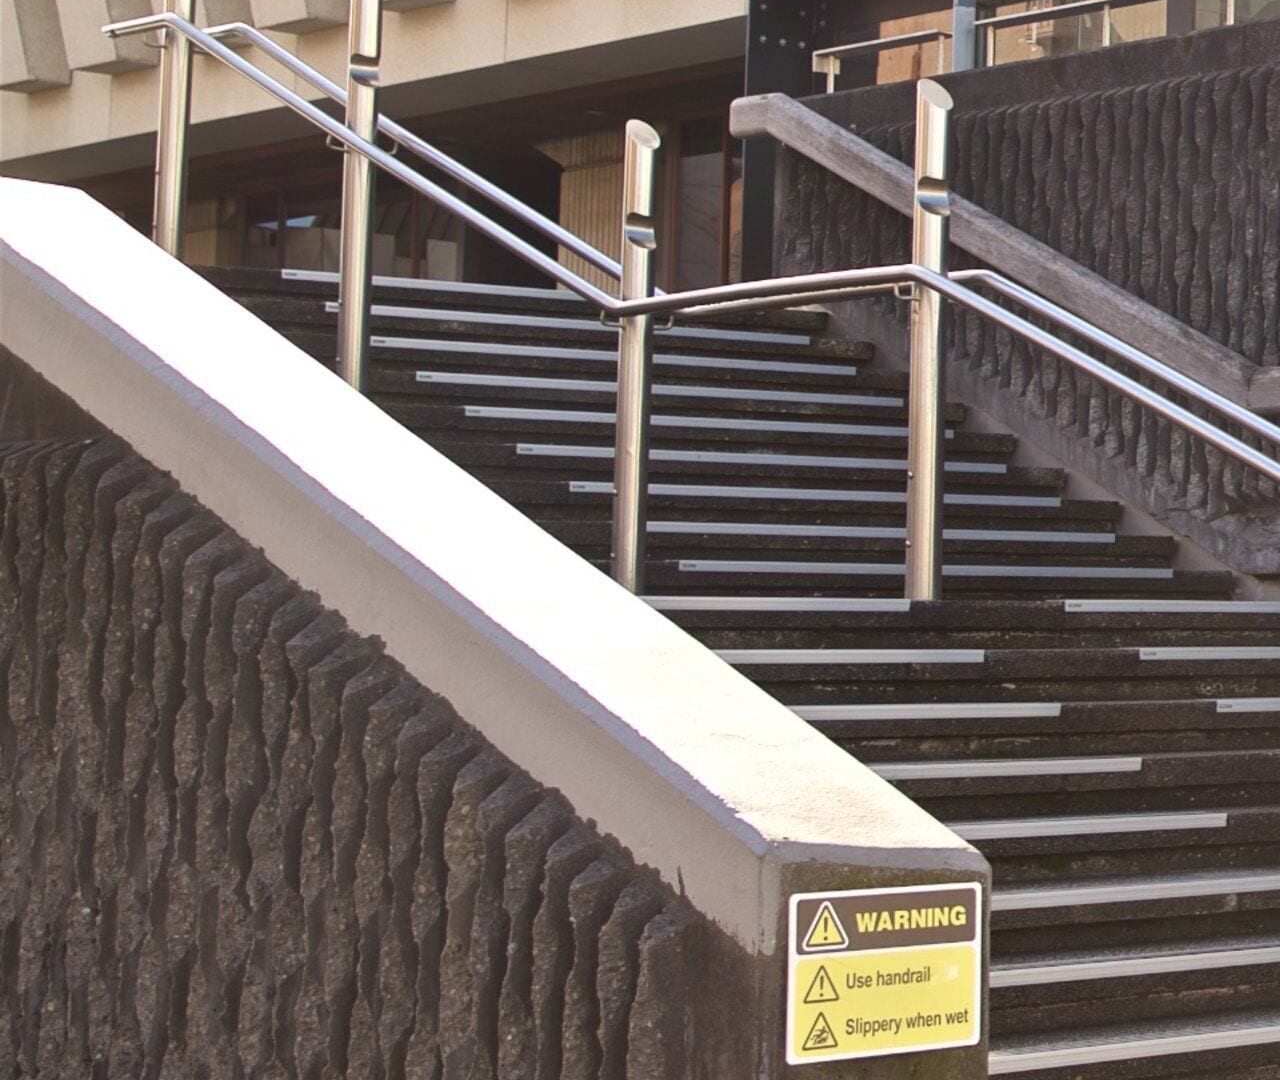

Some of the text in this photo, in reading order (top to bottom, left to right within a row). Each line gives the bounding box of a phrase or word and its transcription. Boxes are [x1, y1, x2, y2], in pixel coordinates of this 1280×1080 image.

[856, 905, 967, 933] WARNING
[846, 966, 931, 989] Use handrail
[846, 1008, 969, 1037] Slippery when wet
